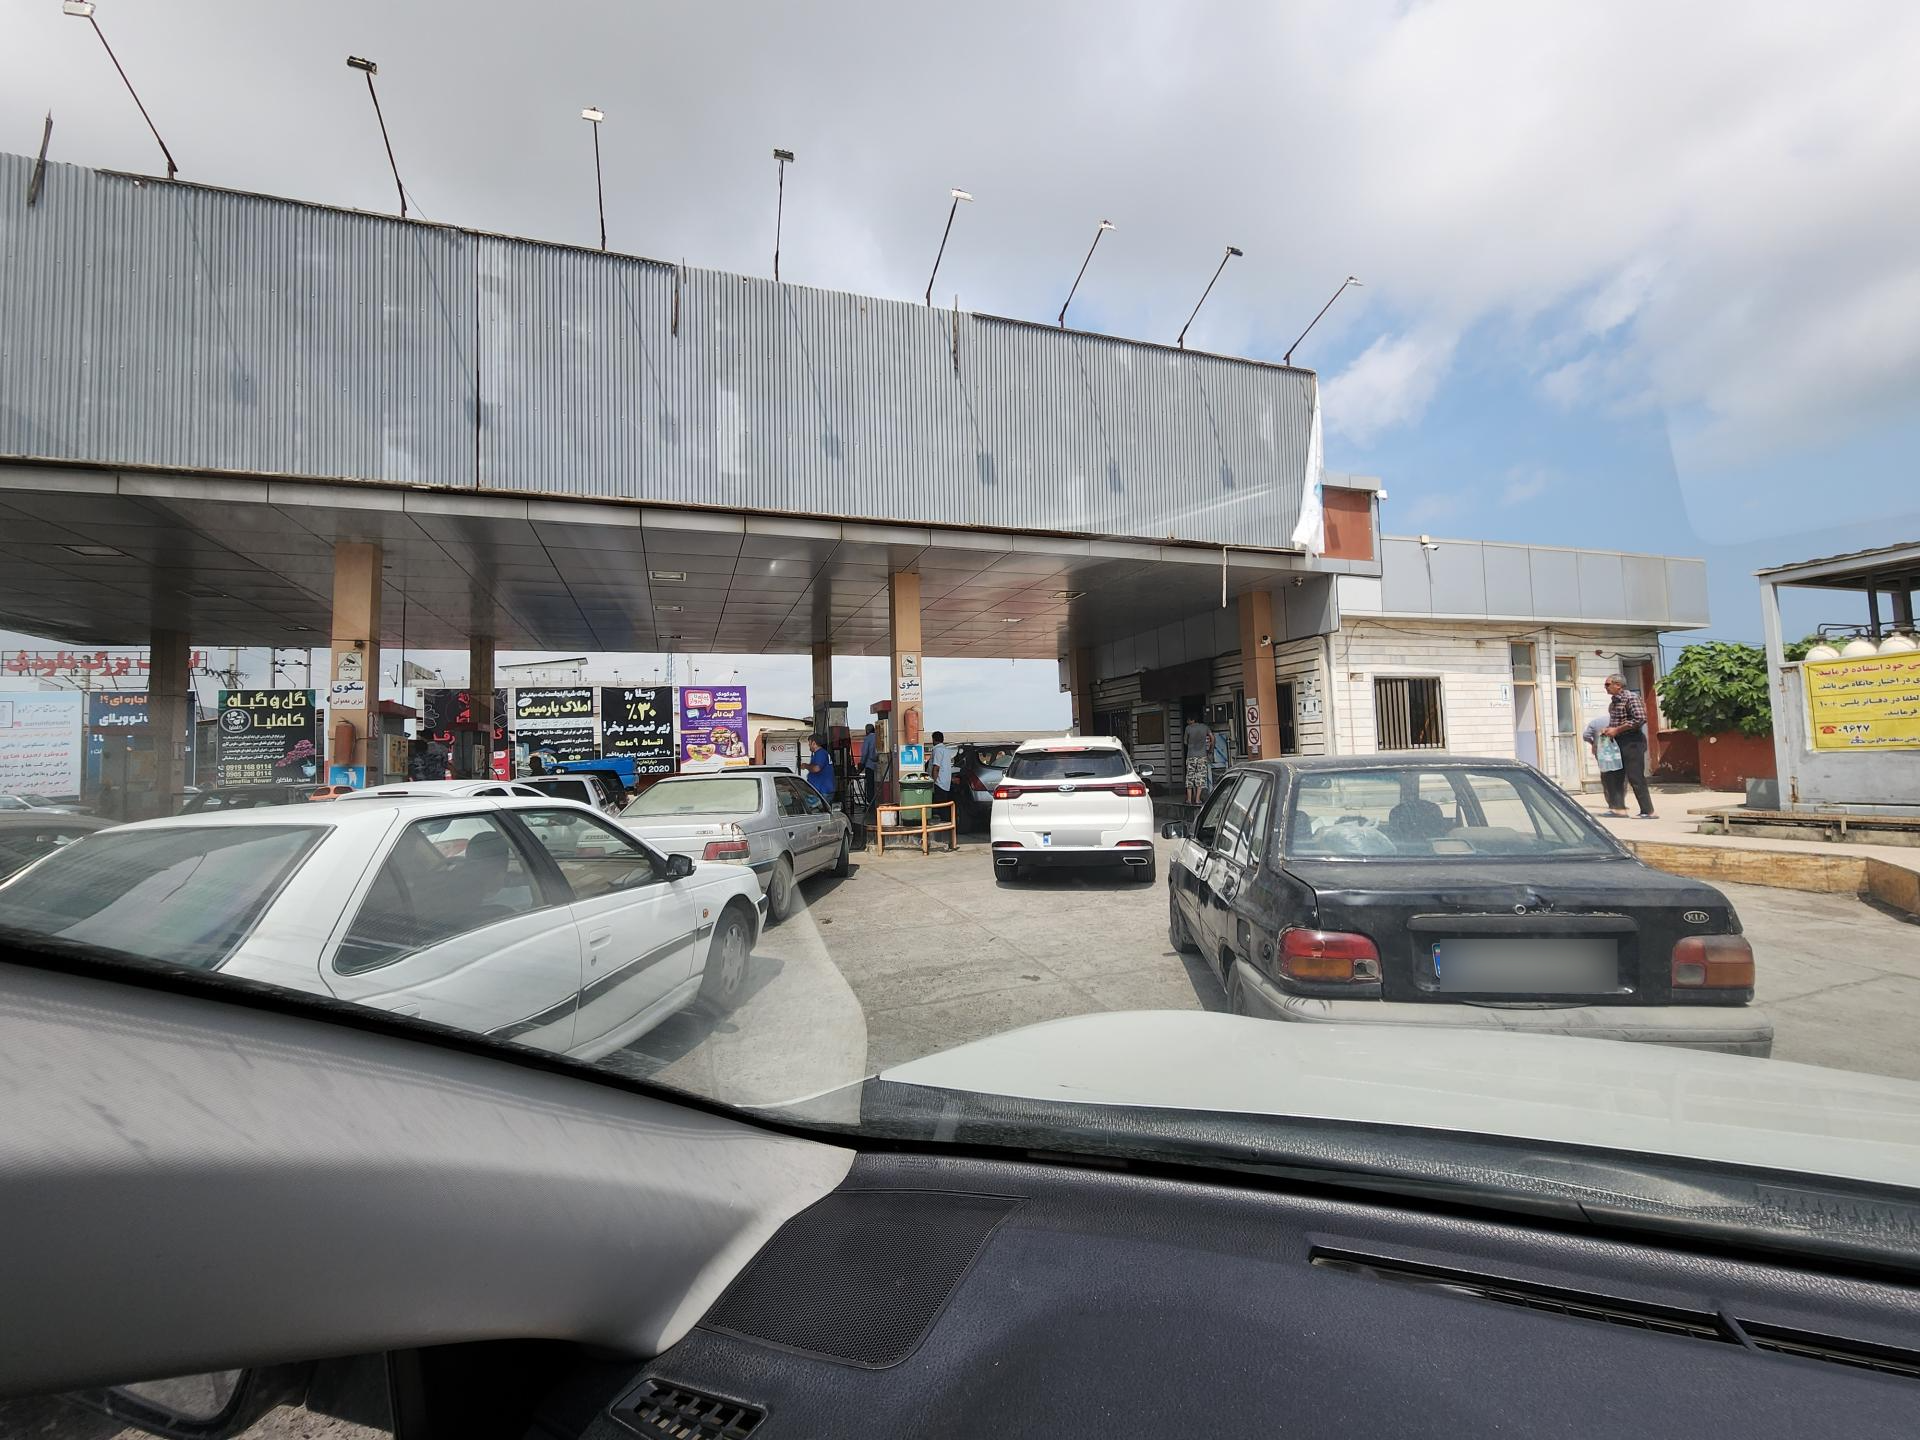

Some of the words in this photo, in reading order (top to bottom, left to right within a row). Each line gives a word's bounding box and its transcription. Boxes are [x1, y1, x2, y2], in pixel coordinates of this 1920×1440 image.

[80, 650, 131, 676] بزرگ
[1886, 663, 1904, 672] خود
[1851, 664, 1882, 673] استفاده
[899, 679, 919, 689] سکوی
[1878, 677, 1899, 687] اختیار
[1902, 677, 1910, 685] در
[332, 681, 364, 693] سکوی
[624, 691, 633, 700] رو
[635, 689, 655, 700] ویلا
[227, 691, 267, 709] گیاه
[270, 695, 280, 709] و
[282, 691, 306, 709] گل
[519, 700, 560, 717] پارمیس
[560, 700, 592, 713] املاک
[712, 710, 722, 719] نام
[722, 710, 734, 718] ثبت
[254, 713, 304, 729] کاملیا
[603, 720, 624, 736] بخر!
[626, 720, 655, 734] قیمت
[656, 722, 670, 735] زیر
[1838, 724, 1870, 734] ۰۹۶۲۷
[641, 738, 663, 746] اقساط
[648, 765, 670, 773] 2020
[1687, 913, 1706, 922] KIA
